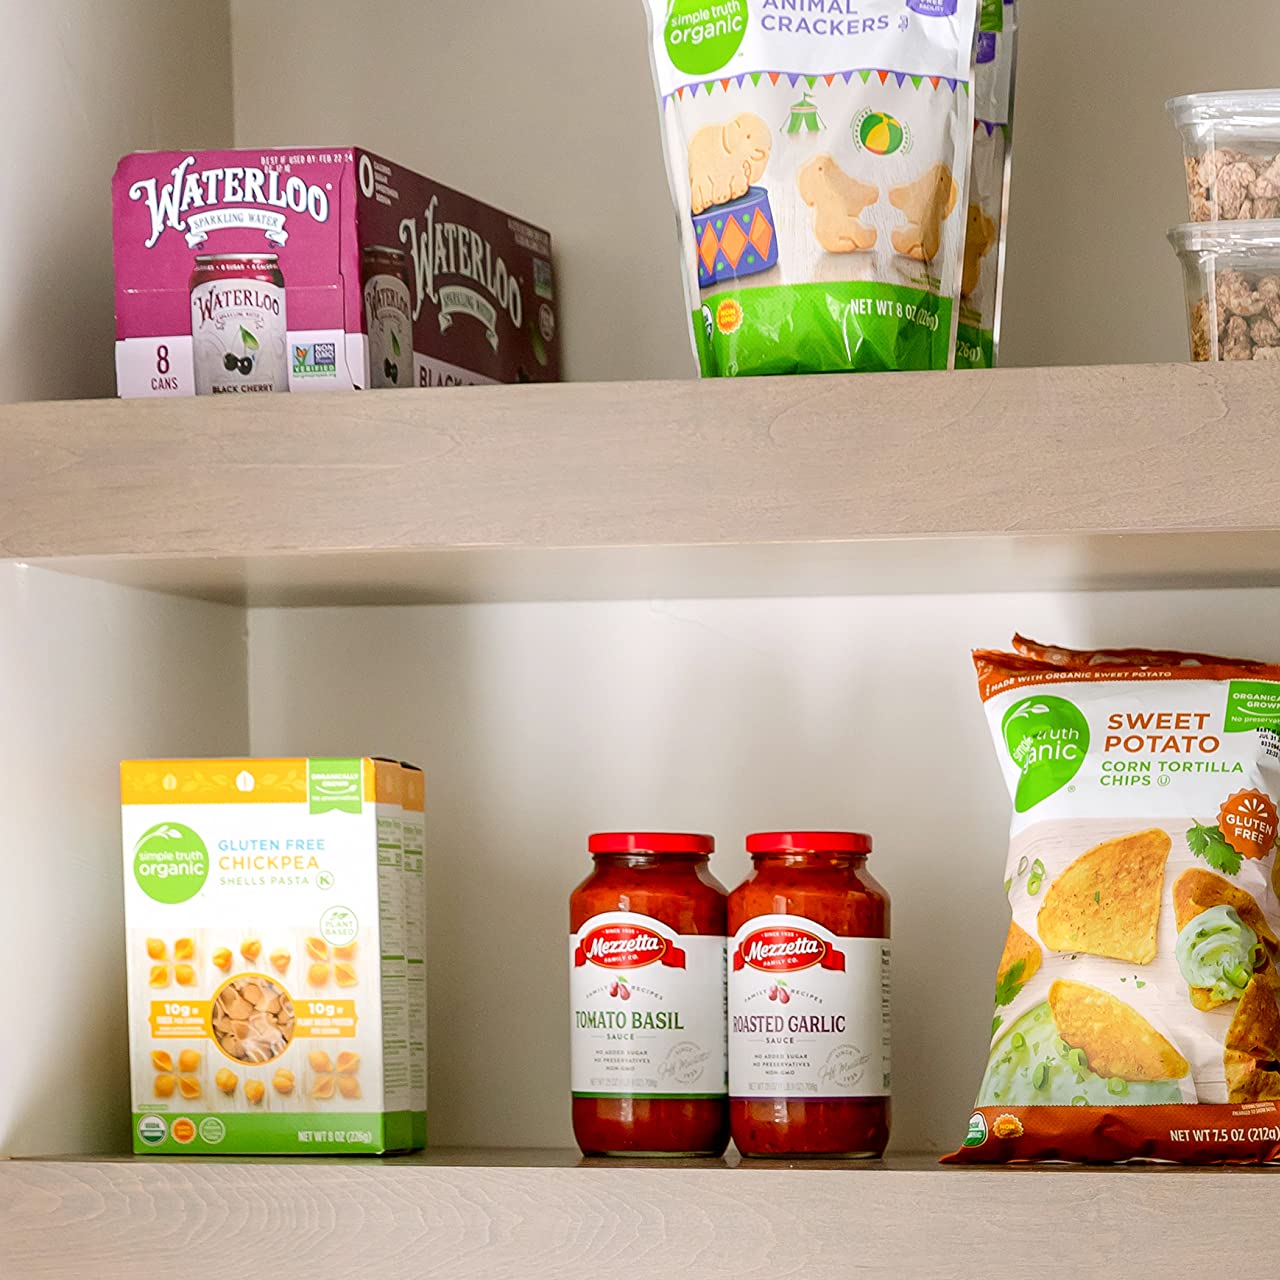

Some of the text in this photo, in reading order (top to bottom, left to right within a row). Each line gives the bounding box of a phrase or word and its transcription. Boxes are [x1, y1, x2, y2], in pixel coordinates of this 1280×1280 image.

[671, 0, 740, 27] simple truth
[762, 0, 858, 14] ANIMAL
[670, 15, 742, 45] organic
[760, 14, 889, 36] CRACKERS
[359, 154, 374, 198] 0
[129, 156, 330, 248] WATERLOO
[193, 213, 280, 230] SPARKLING WATER
[399, 195, 522, 329] WATERLOO
[193, 285, 280, 329] WATERLOO
[850, 298, 872, 316] NET
[876, 301, 893, 317] WT
[896, 303, 903, 318] 8
[905, 305, 917, 321] OZ
[157, 345, 169, 375] 8
[151, 377, 178, 390] CANS
[212, 383, 273, 393] BLACK CHERRY
[991, 678, 1015, 691] MADE
[1017, 674, 1043, 683] WITH
[1045, 671, 1092, 680] ORGANIC
[1107, 713, 1211, 731] SWEET
[1104, 735, 1221, 754] POTATO
[1101, 760, 1244, 773] CORN TORTILLA
[1100, 774, 1152, 786] CHIPS
[1226, 814, 1273, 835] GLUTEN
[1235, 827, 1264, 844] FREE
[218, 839, 325, 851] GLUTEN FREE
[139, 850, 204, 864] simple truth
[218, 855, 320, 870] CHICKPEA
[138, 861, 205, 879] organic
[219, 875, 309, 886] SHELLS PASTA
[325, 920, 353, 928] PLANT
[325, 928, 354, 936] BASED
[586, 934, 659, 959] Mezzetta
[744, 937, 818, 962] Mezzetta
[604, 955, 626, 964] FAMILY
[763, 958, 785, 967] FAMILY
[631, 985, 664, 1001] RECIPES
[790, 989, 823, 1005] RECIPES
[164, 1003, 190, 1016] 10g
[308, 1003, 335, 1016] 10g
[575, 1011, 684, 1030] TOMATO BASIL
[733, 1015, 846, 1033] ROASTED GARLIC
[297, 1130, 312, 1142] NET
[1170, 1129, 1190, 1142] NET
[1192, 1129, 1210, 1142] WT
[1212, 1129, 1229, 1142] 7.5
[1230, 1128, 1246, 1142] OZ
